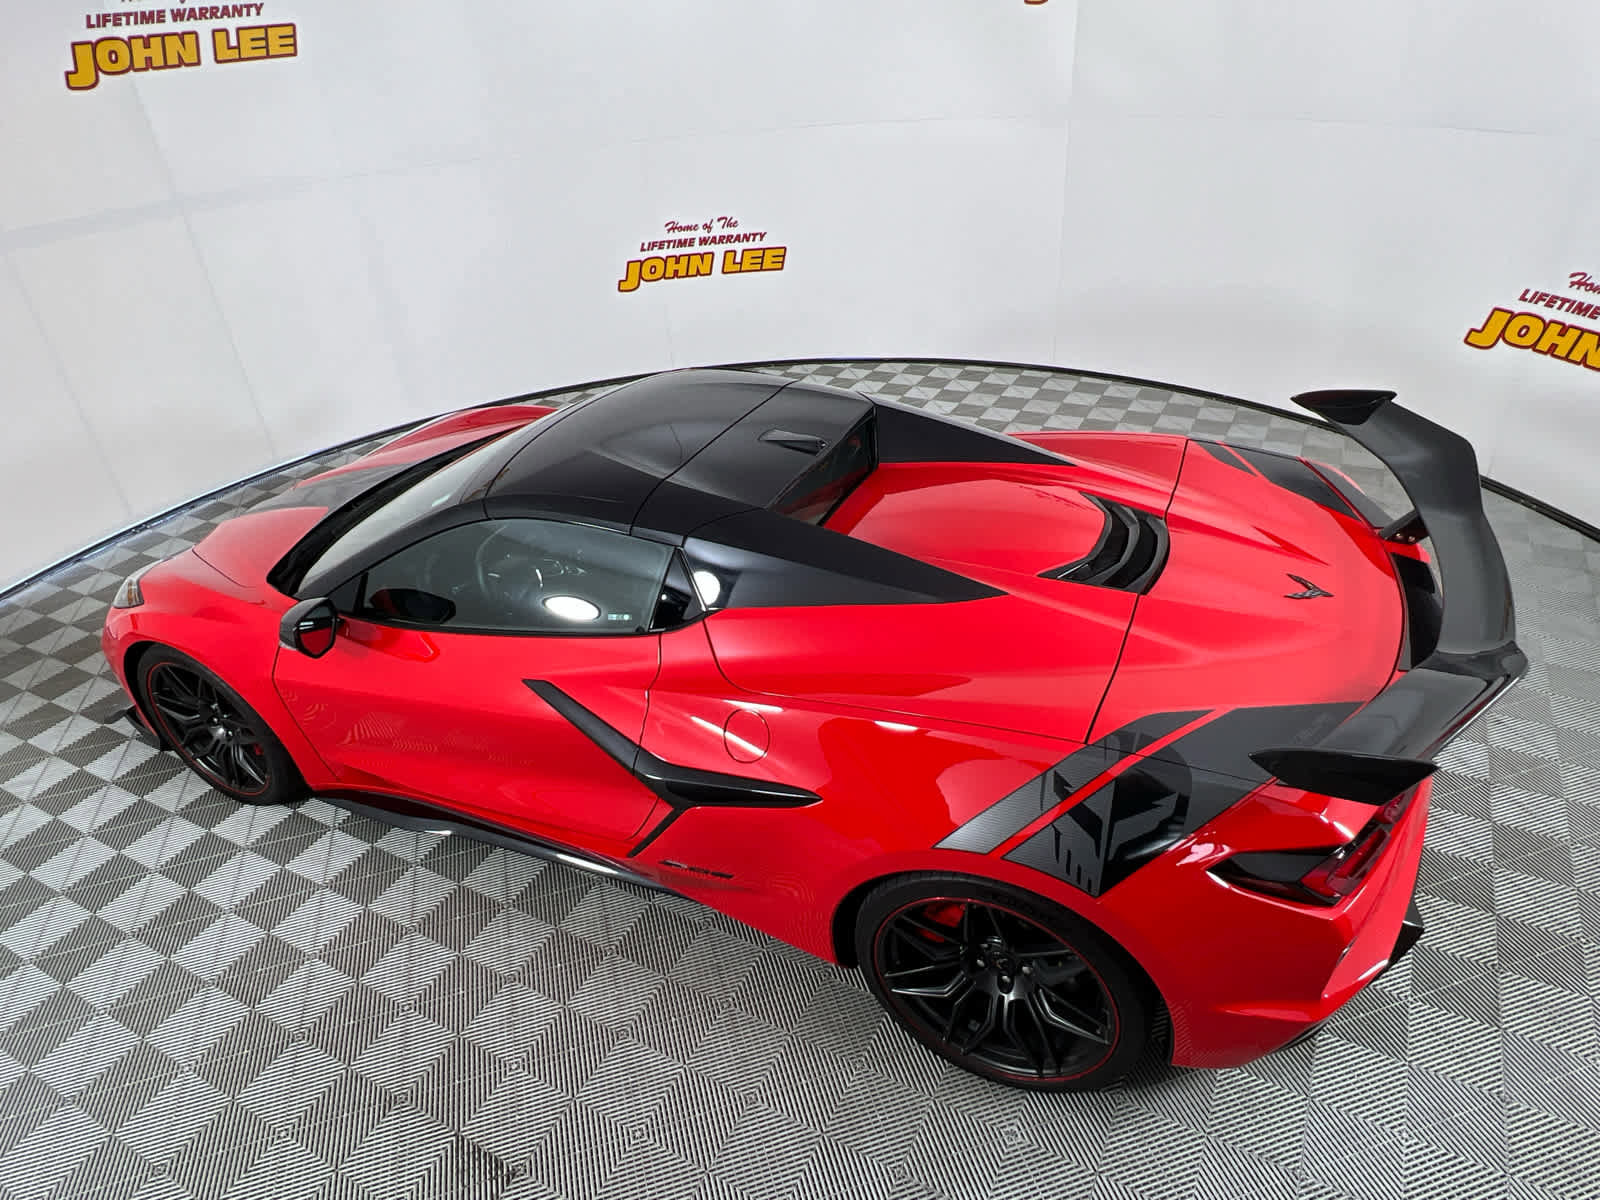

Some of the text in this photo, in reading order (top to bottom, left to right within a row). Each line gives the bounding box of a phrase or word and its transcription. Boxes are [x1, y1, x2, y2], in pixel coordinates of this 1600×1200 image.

[86, 3, 264, 28] LIFETIME WARRANTY
[64, 23, 298, 90] JOHN LEE
[664, 217, 739, 233] Home of The
[640, 232, 767, 252] LIFETIME WARRANTY
[617, 247, 787, 292] JOHN LEE
[1518, 288, 1600, 320] LIFETIME
[1464, 307, 1600, 372] JOHN
